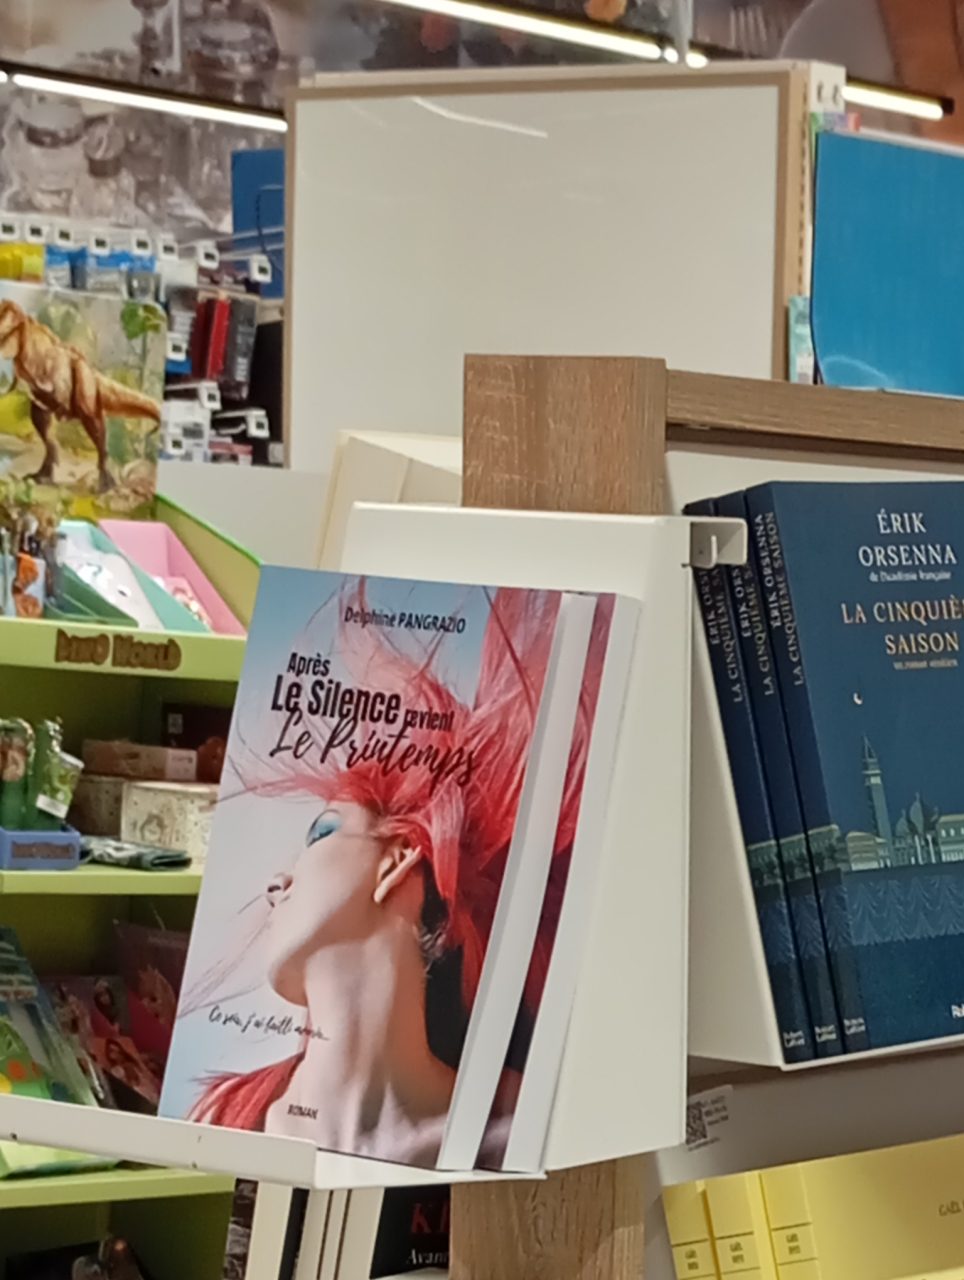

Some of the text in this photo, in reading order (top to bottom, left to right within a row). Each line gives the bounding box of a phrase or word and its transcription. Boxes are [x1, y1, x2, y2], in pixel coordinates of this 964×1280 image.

[877, 508, 927, 534] ÉRIK
[858, 544, 958, 567] ORSENNA
[344, 606, 466, 634] Delphine PANGRAZIO
[840, 602, 867, 625] LA
[884, 631, 960, 656] SAISON
[286, 651, 331, 678] Après
[271, 674, 302, 713] Le
[307, 678, 402, 725] Silence
[268, 708, 484, 797] Le Printemps
